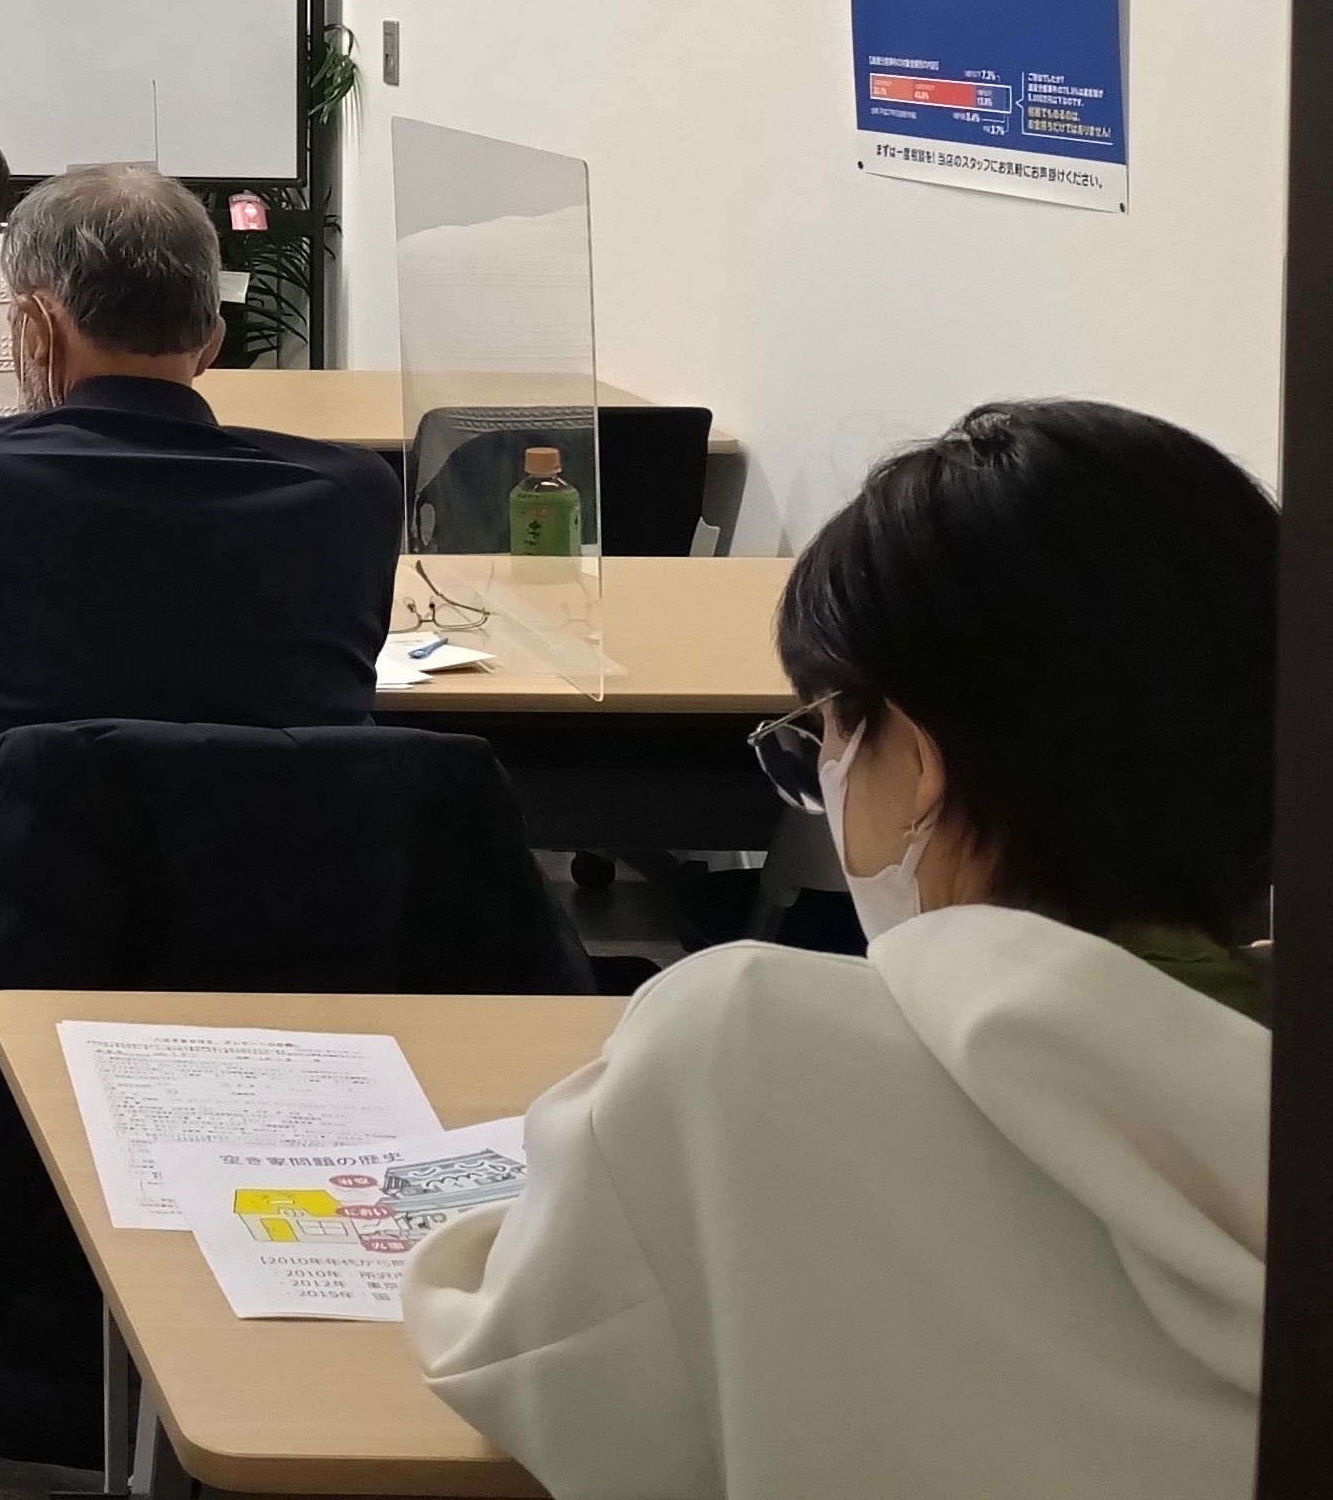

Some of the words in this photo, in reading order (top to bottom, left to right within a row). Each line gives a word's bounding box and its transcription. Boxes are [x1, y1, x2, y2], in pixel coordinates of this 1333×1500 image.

[219, 1152, 405, 1166] 空き家問題の歴史
[344, 1206, 388, 1217] におい
